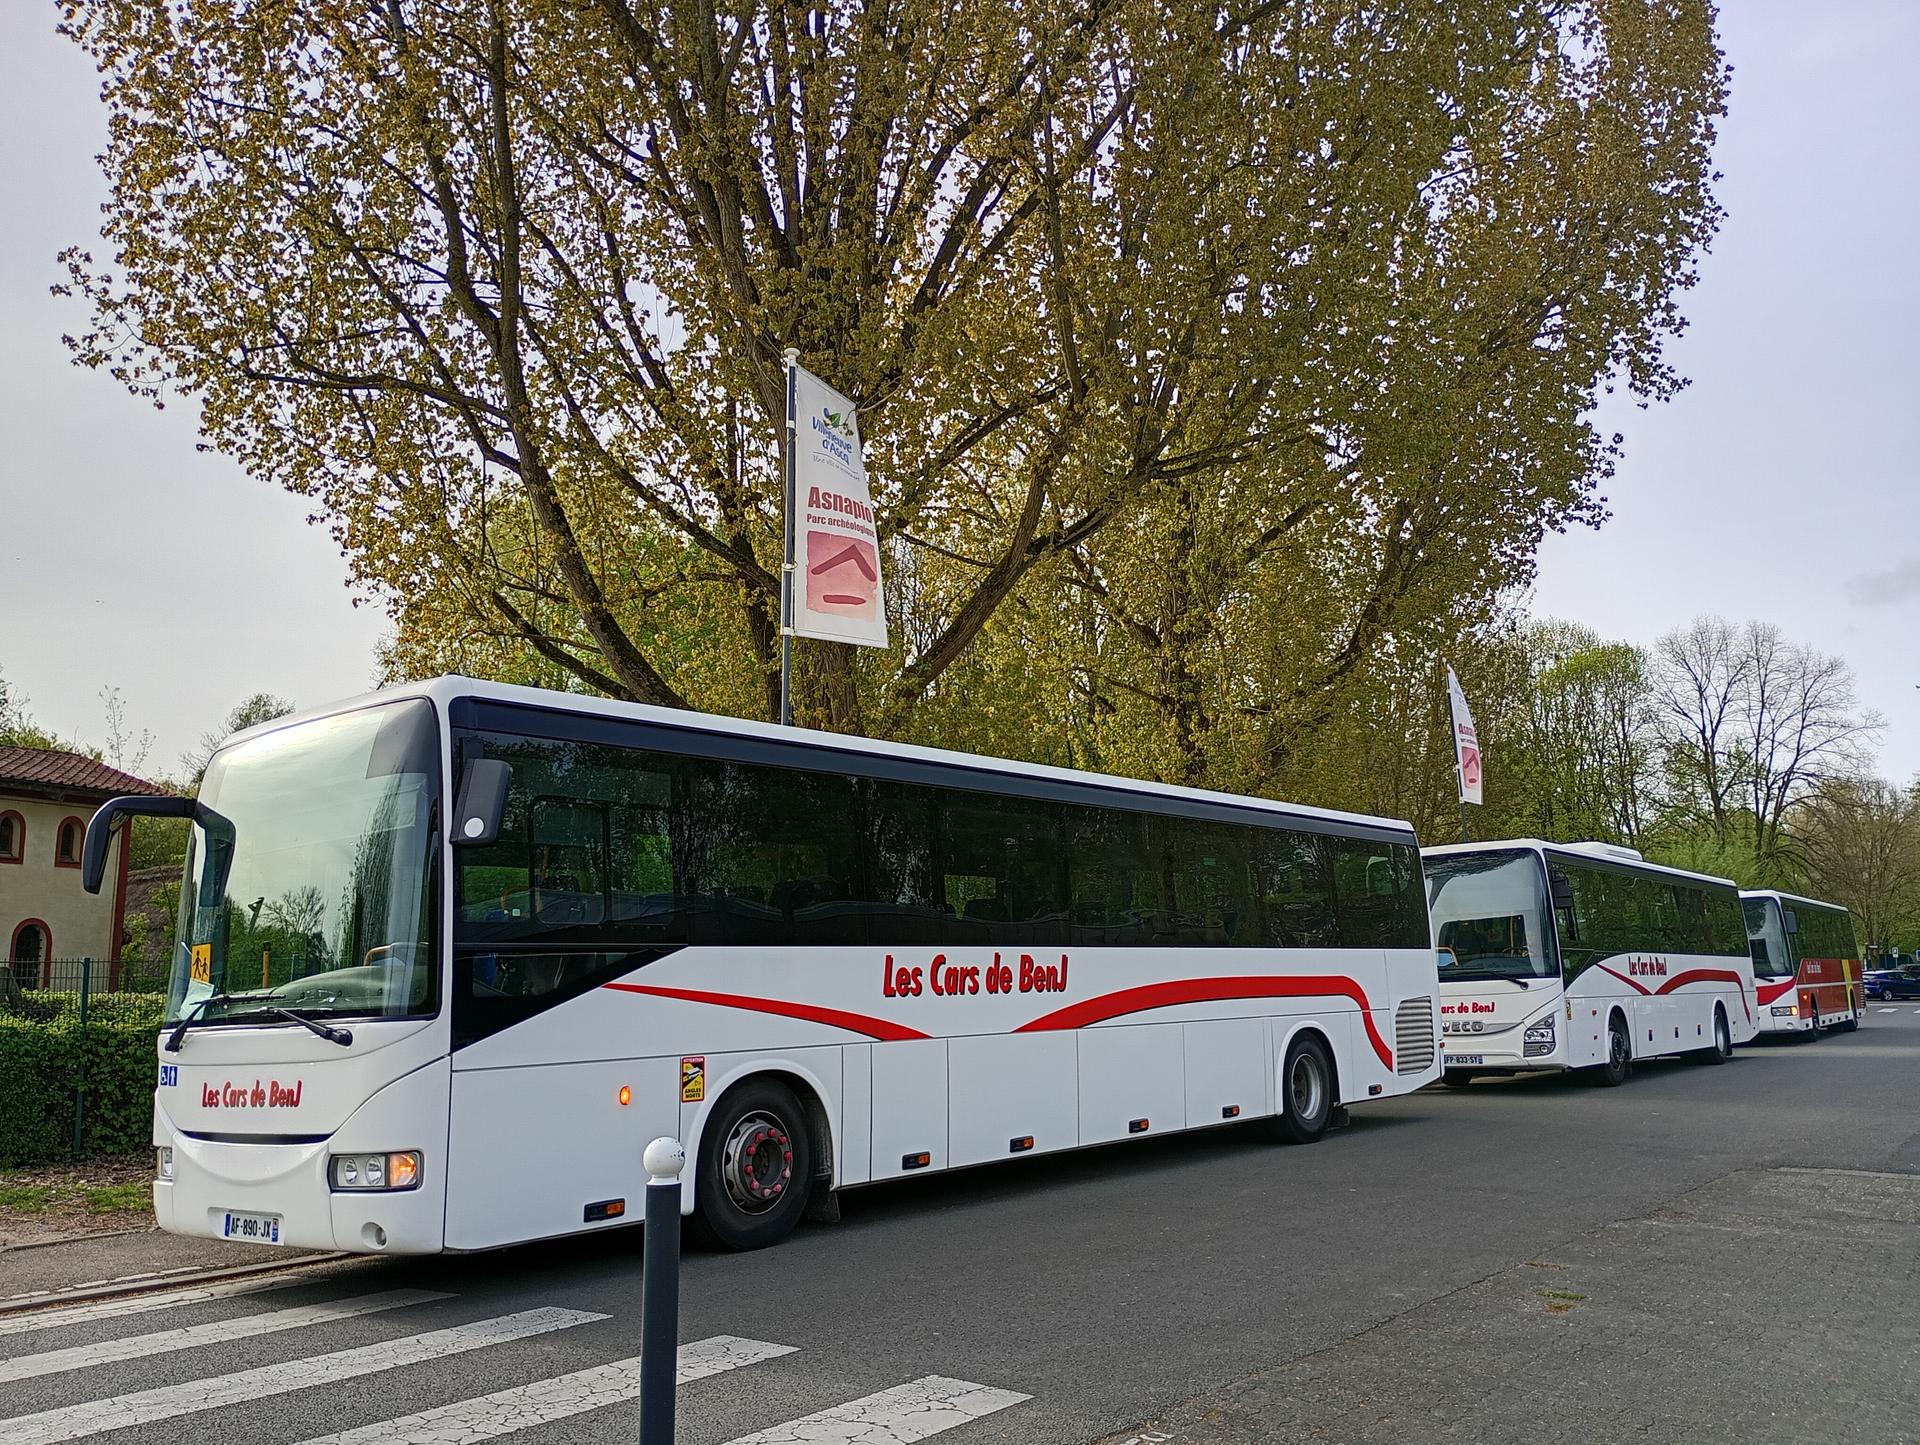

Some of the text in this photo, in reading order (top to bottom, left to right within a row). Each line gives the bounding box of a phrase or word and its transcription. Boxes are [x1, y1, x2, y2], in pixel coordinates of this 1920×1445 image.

[812, 416, 852, 453] Villeneuve
[807, 513, 826, 525] Parc
[808, 486, 872, 524] Asnapio
[883, 952, 1069, 998] Les Cars de BenJ
[1441, 1001, 1495, 1014] ars de BenJ
[1442, 1021, 1483, 1032] VECO
[202, 1079, 302, 1108] Les Cars de BenJ
